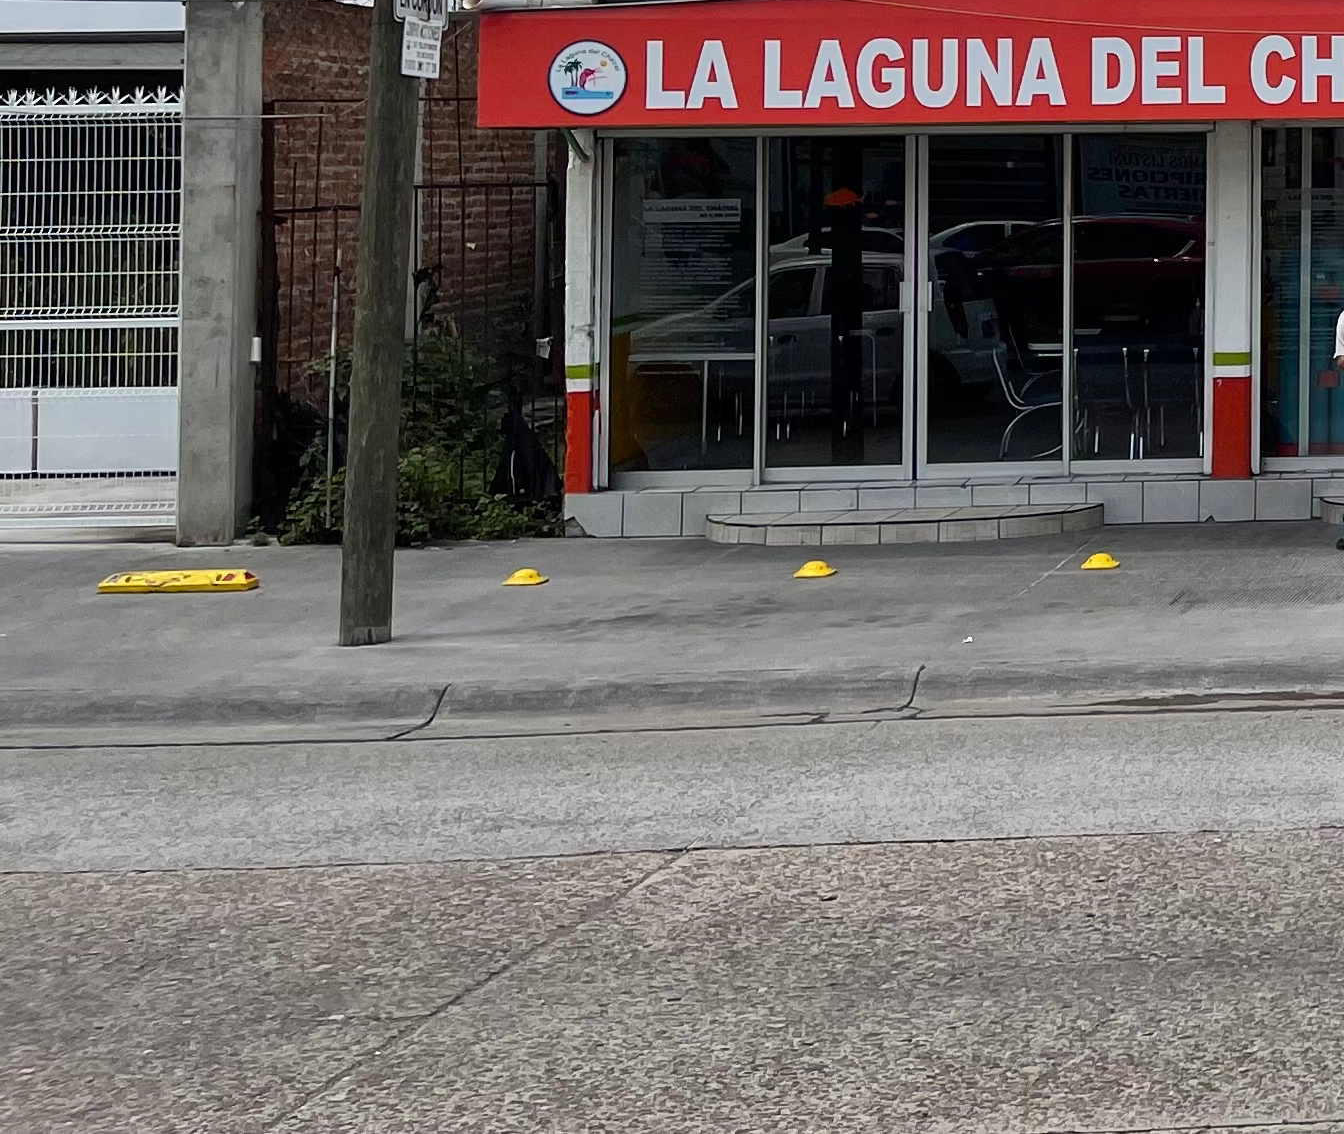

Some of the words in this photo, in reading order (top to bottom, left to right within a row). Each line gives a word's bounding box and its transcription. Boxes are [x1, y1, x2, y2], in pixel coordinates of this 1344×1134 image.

[645, 39, 739, 109] LA
[762, 36, 1067, 109] LAGUNA
[1091, 35, 1226, 106] DEL
